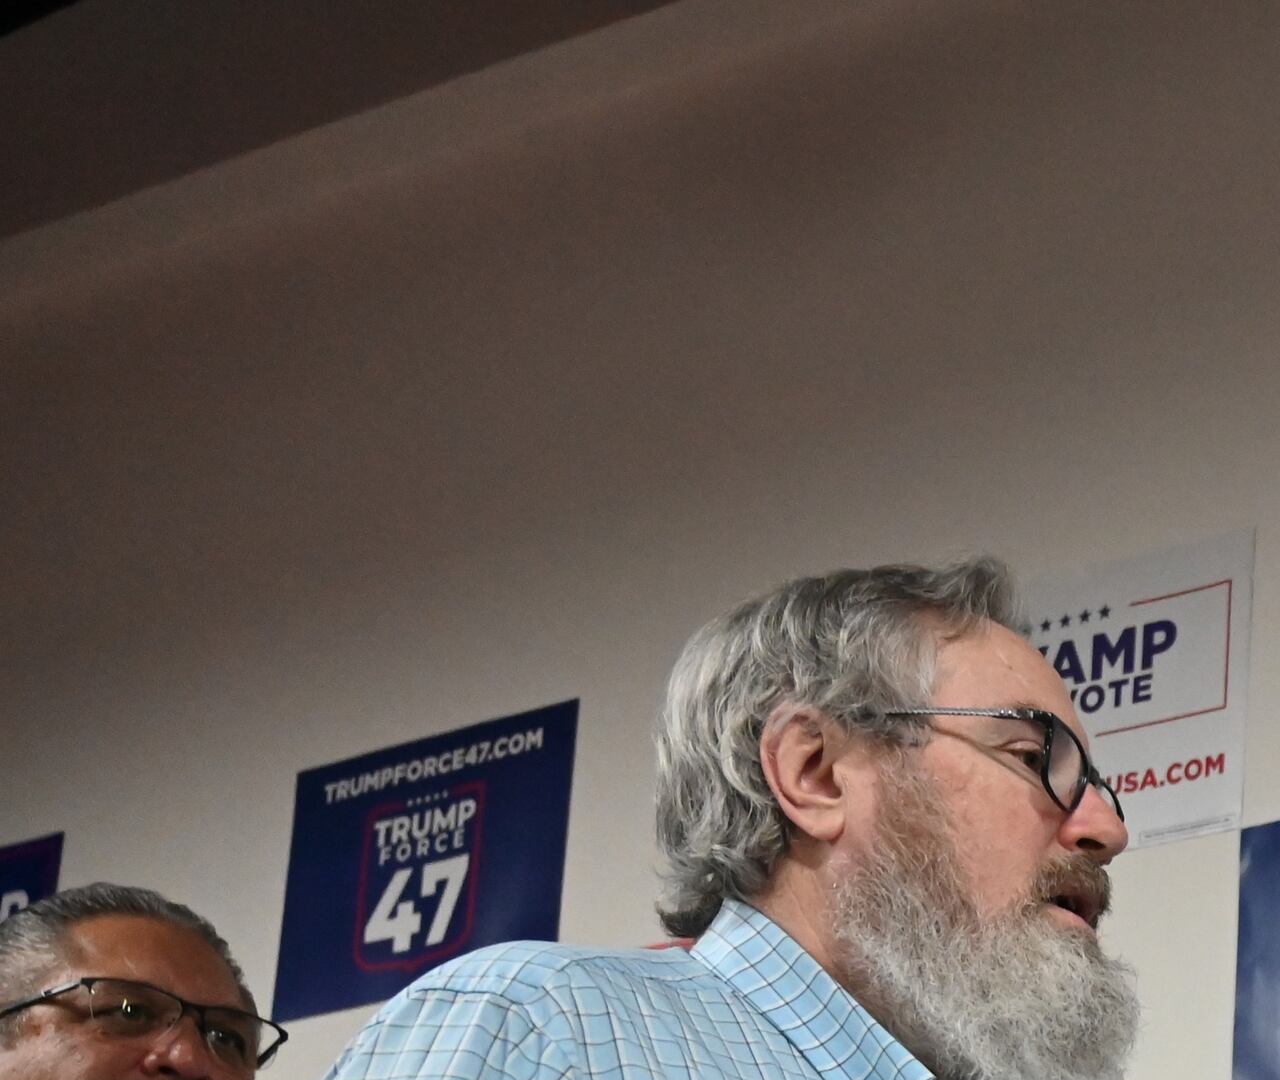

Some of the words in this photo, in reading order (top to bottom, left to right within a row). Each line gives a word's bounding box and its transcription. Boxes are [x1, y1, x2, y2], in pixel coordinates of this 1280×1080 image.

[1038, 620, 1177, 684] AMP
[1070, 673, 1153, 713] OTE
[324, 728, 544, 804] TRUMPFORCE47.COM
[374, 799, 476, 848] TRUMP
[379, 828, 465, 866] FORCE
[363, 853, 470, 953] 47
